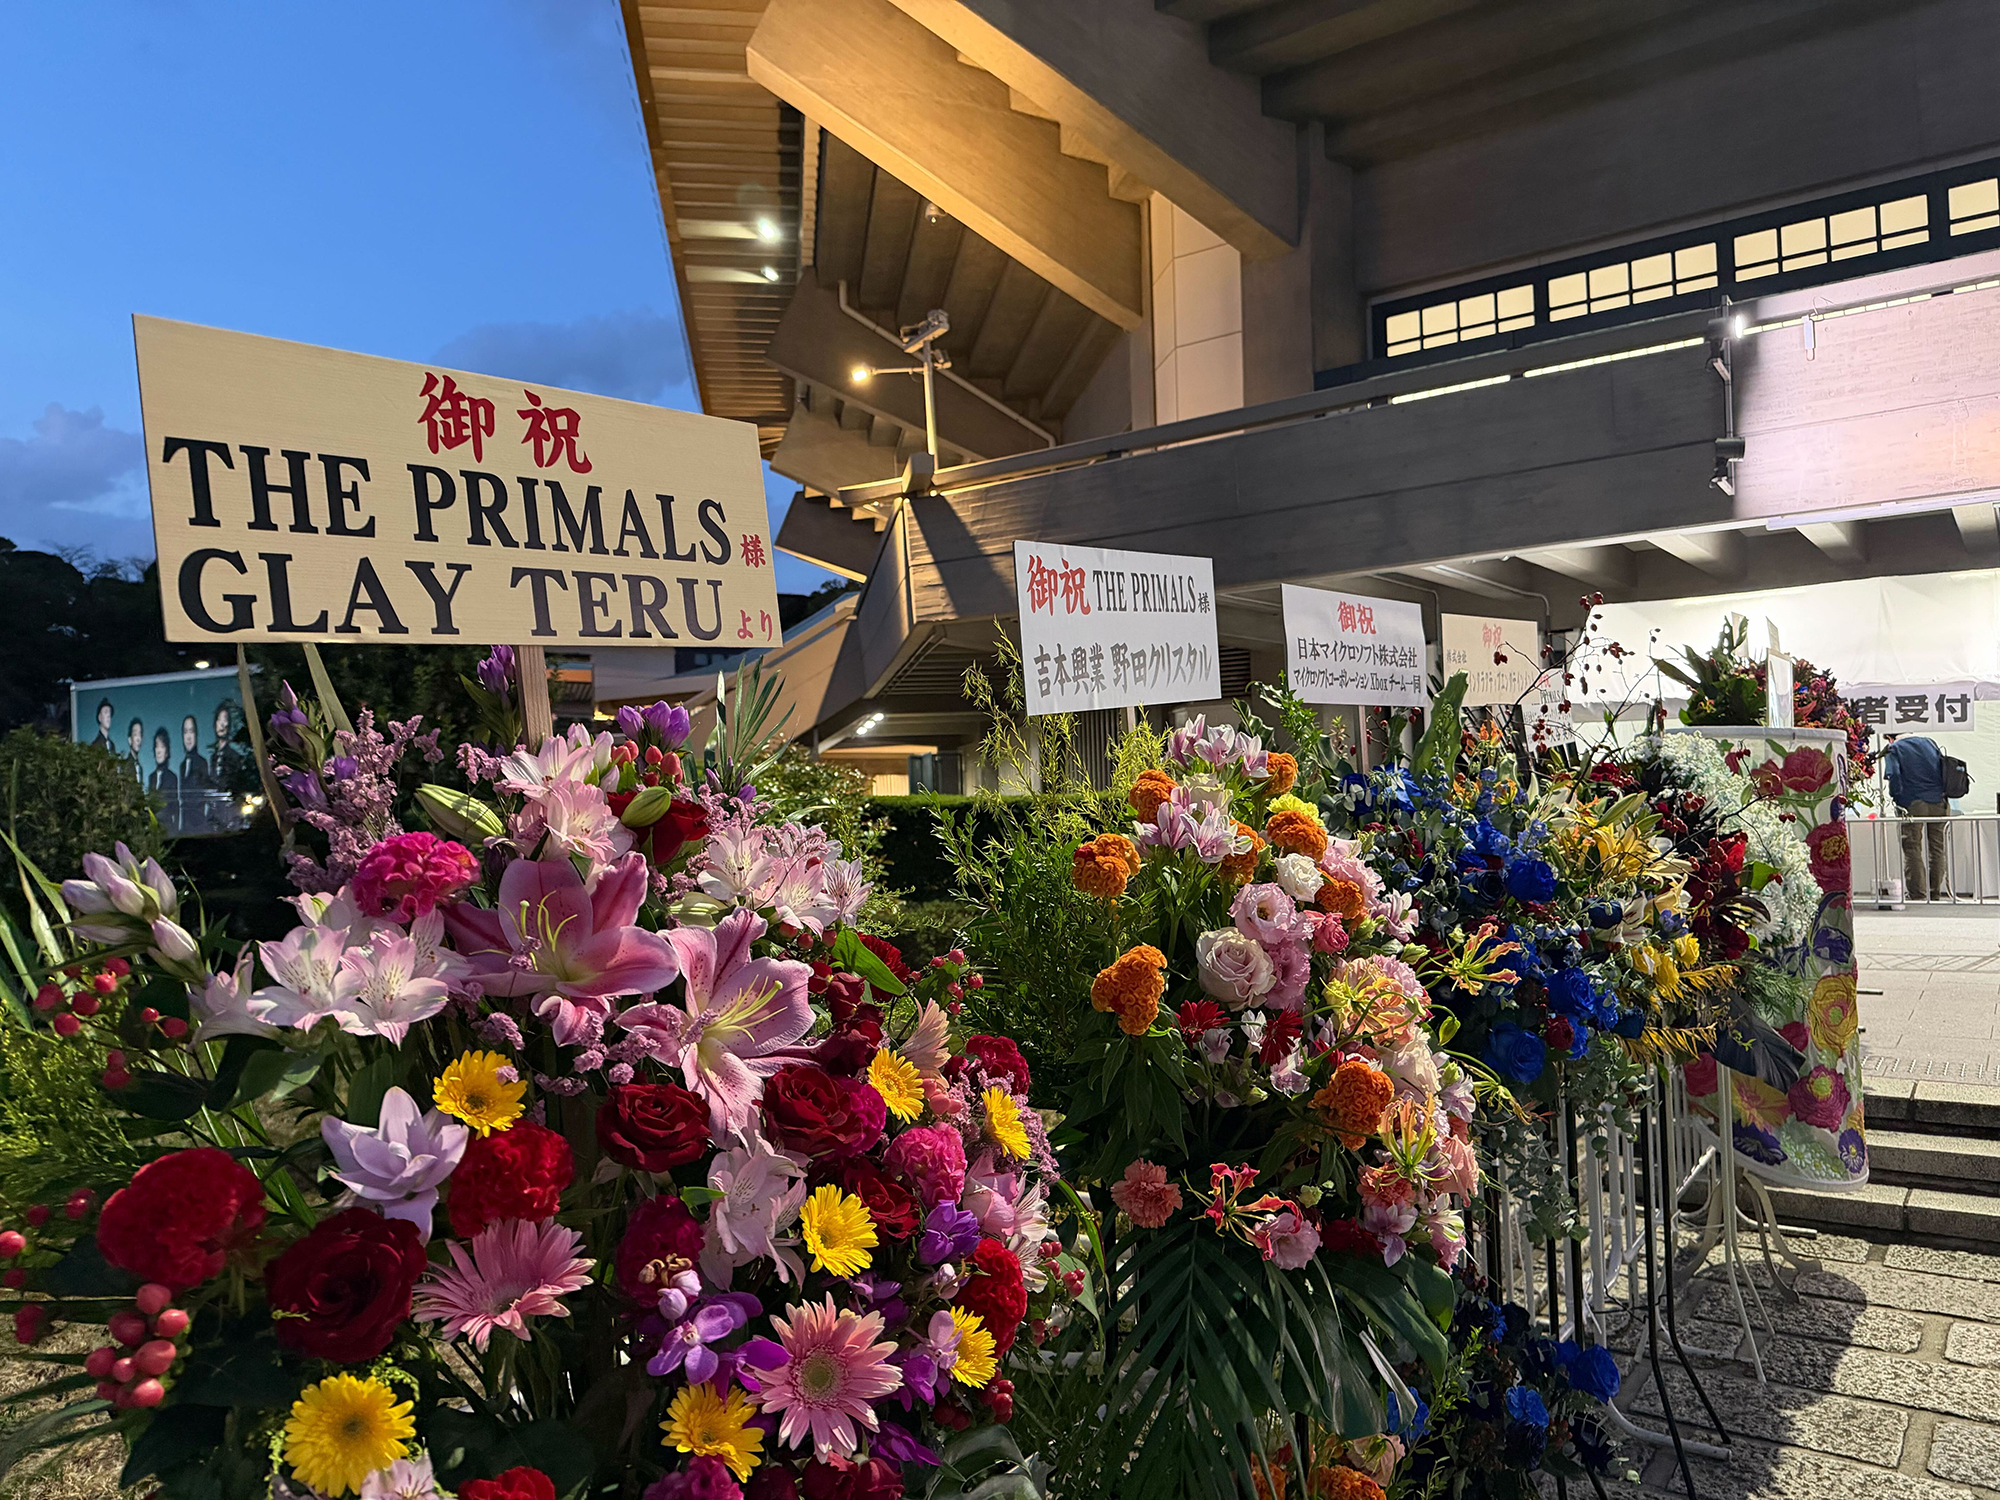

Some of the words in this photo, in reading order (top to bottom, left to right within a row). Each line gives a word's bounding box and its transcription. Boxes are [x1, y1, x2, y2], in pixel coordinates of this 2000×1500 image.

[162, 436, 376, 538] THE
[407, 462, 733, 566] PRIMALS
[740, 533, 767, 569] 様
[178, 547, 472, 636] GLAY
[510, 566, 724, 641] TERU
[737, 609, 773, 643] より
[1026, 554, 1091, 616] 御祝
[1092, 570, 1127, 612] THE
[1130, 572, 1196, 613] PRIMALS
[1337, 600, 1376, 635] 御祝
[1033, 642, 1107, 698] 吉本興業
[1110, 642, 1212, 694] 野田クリスタル
[1297, 637, 1418, 669] 日本マイクロソフト株式会社
[1846, 693, 1971, 725] 者受付
